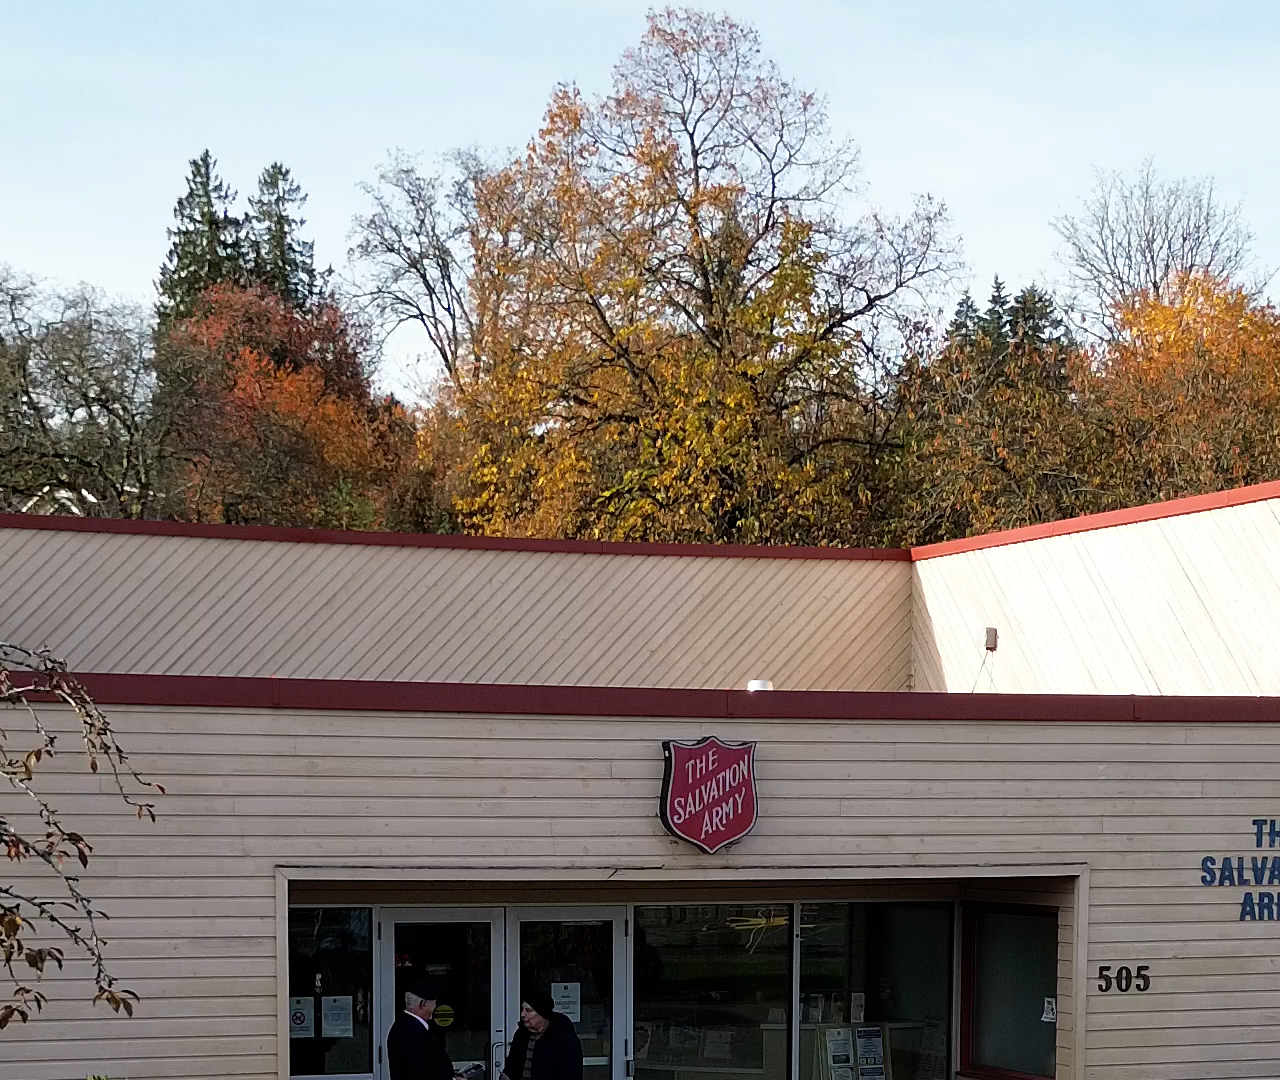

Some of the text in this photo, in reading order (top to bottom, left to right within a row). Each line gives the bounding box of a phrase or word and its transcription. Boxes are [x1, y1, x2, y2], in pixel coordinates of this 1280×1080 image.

[685, 747, 718, 784] THE
[673, 754, 749, 824] SALVATION
[700, 787, 746, 840] ARMY
[1097, 965, 1151, 993] 505
